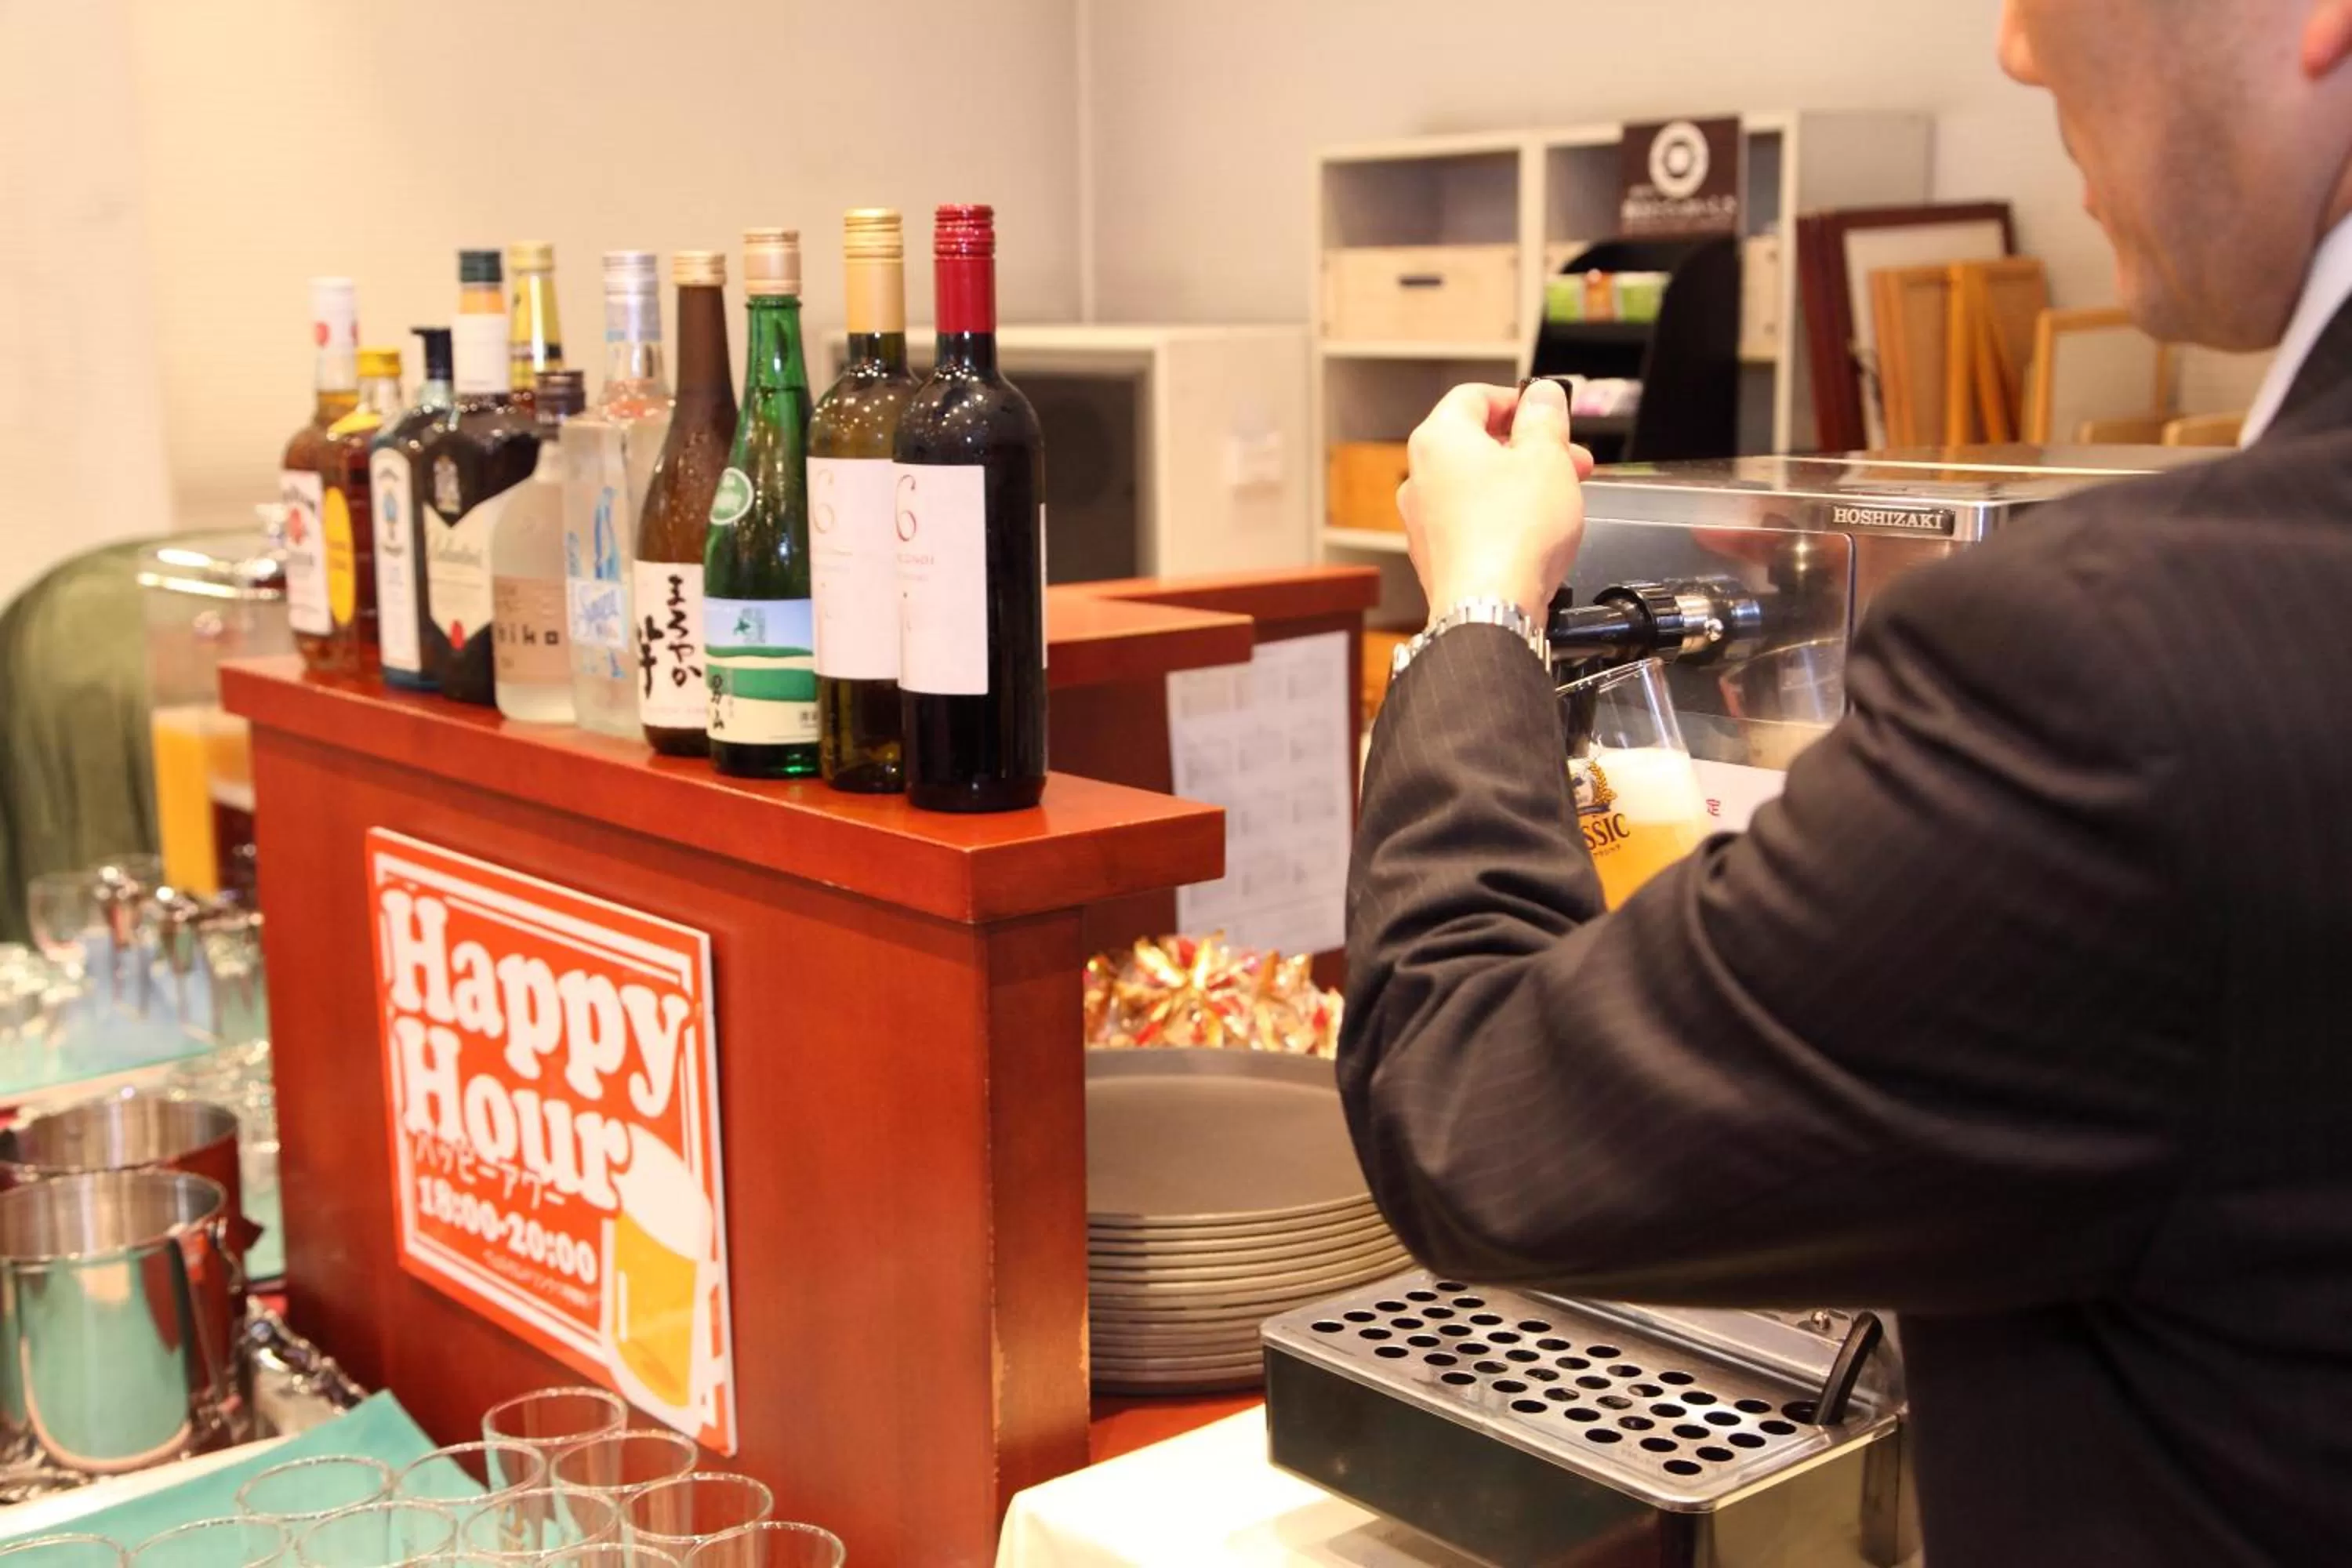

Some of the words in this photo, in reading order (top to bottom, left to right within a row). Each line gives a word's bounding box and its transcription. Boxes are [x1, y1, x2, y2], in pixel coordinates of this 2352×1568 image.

[1833, 506, 1943, 530] HOSHIZAKI
[1579, 812, 1630, 851] SSIC
[381, 889, 689, 1118] Happy
[394, 1017, 628, 1210] Hour
